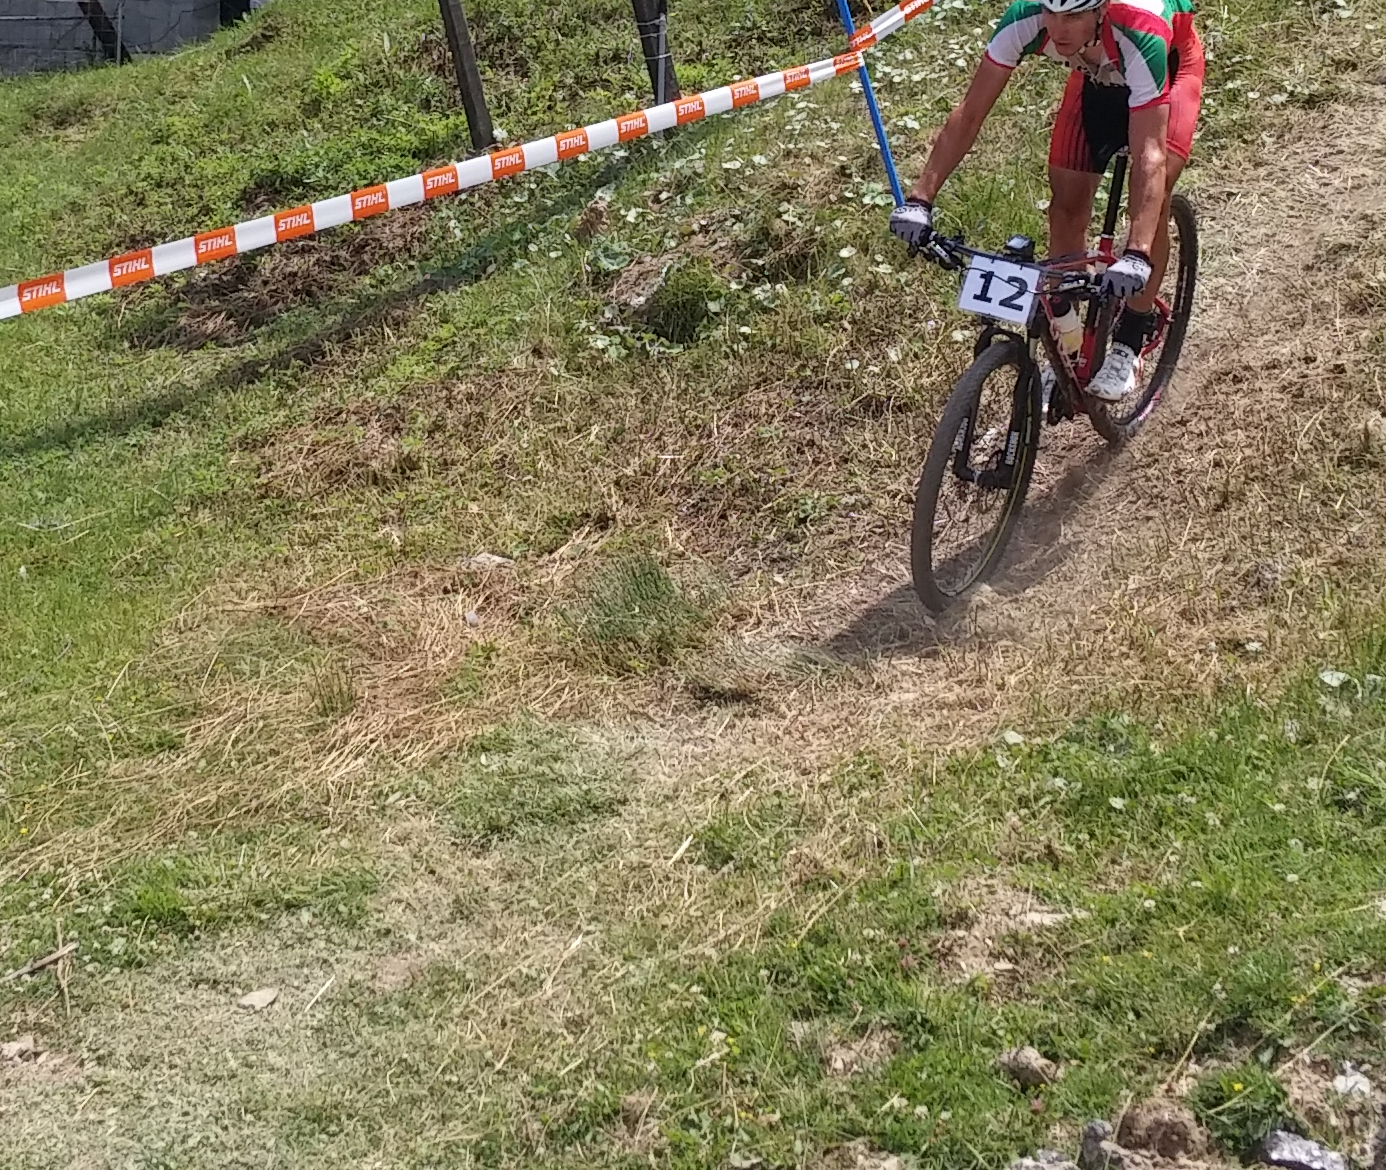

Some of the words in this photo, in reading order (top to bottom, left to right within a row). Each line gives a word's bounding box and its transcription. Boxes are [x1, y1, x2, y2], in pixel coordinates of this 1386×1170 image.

[21, 280, 62, 302] STIHL
[112, 257, 150, 277] STIHL
[198, 235, 233, 253] STIHL
[277, 213, 311, 232] STIHL
[354, 192, 385, 210] STIHL
[426, 171, 455, 190] STIHL
[494, 152, 523, 170] STIHL
[559, 135, 586, 151] STIHL
[620, 117, 646, 133] STIHL
[678, 101, 703, 116] STIHL
[734, 84, 757, 99] STIHL
[973, 270, 1028, 312] 12
